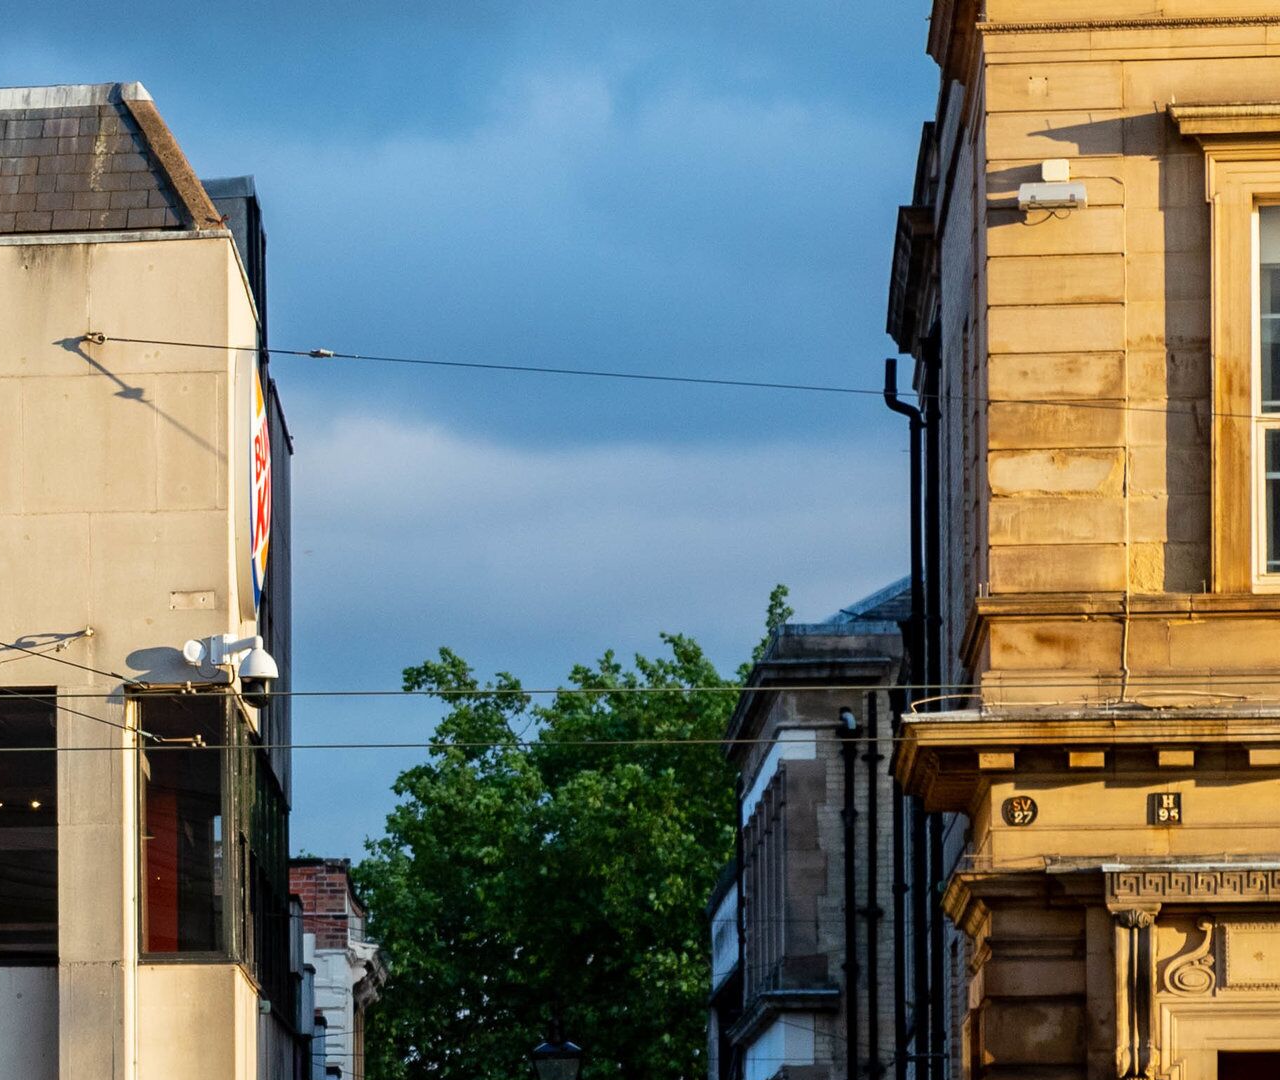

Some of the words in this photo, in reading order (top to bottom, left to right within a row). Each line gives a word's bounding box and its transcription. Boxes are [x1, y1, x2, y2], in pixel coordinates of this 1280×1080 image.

[1013, 799, 1032, 811] SV
[1162, 795, 1174, 808] H
[1014, 811, 1033, 823] 27
